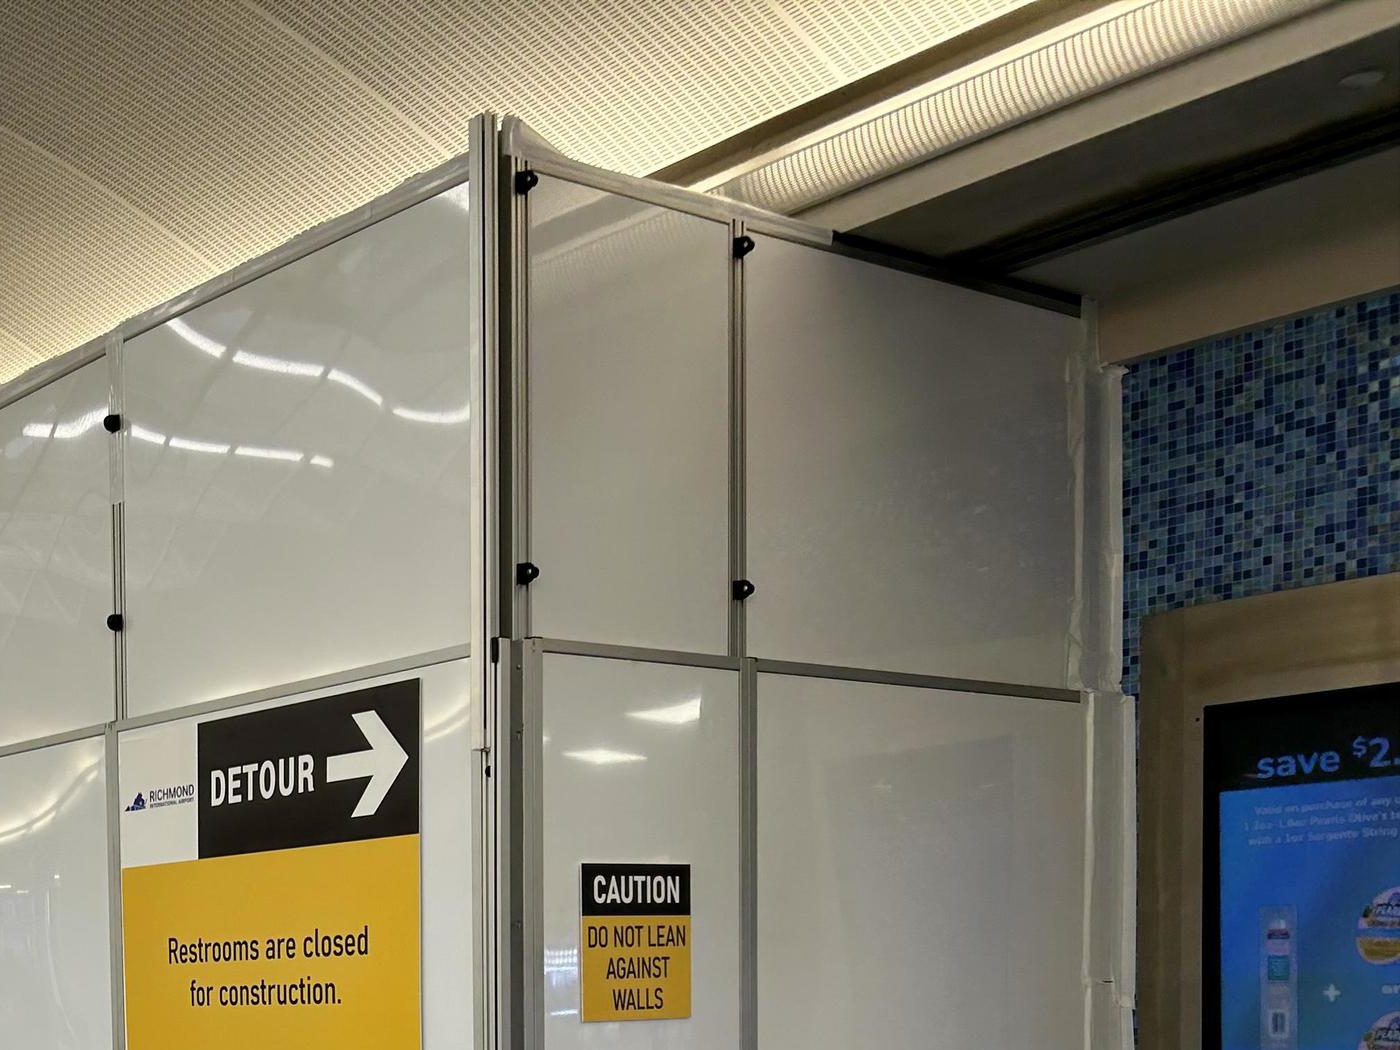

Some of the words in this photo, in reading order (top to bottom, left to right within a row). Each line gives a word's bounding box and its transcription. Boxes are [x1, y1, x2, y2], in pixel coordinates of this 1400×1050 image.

[1256, 751, 1340, 779] save
[150, 784, 194, 802] RICHMOND
[210, 753, 315, 807] DETOUR
[593, 875, 680, 904] CAUTION
[168, 938, 259, 964] Restrooms
[265, 937, 296, 960] are
[303, 925, 368, 957] closed
[588, 926, 608, 948] DO
[614, 926, 643, 948] NOT
[648, 925, 686, 947] LEAN
[606, 957, 670, 979] AGAINST
[190, 980, 213, 1006] for
[219, 976, 342, 1006] construction.
[612, 988, 664, 1011] WALLS
